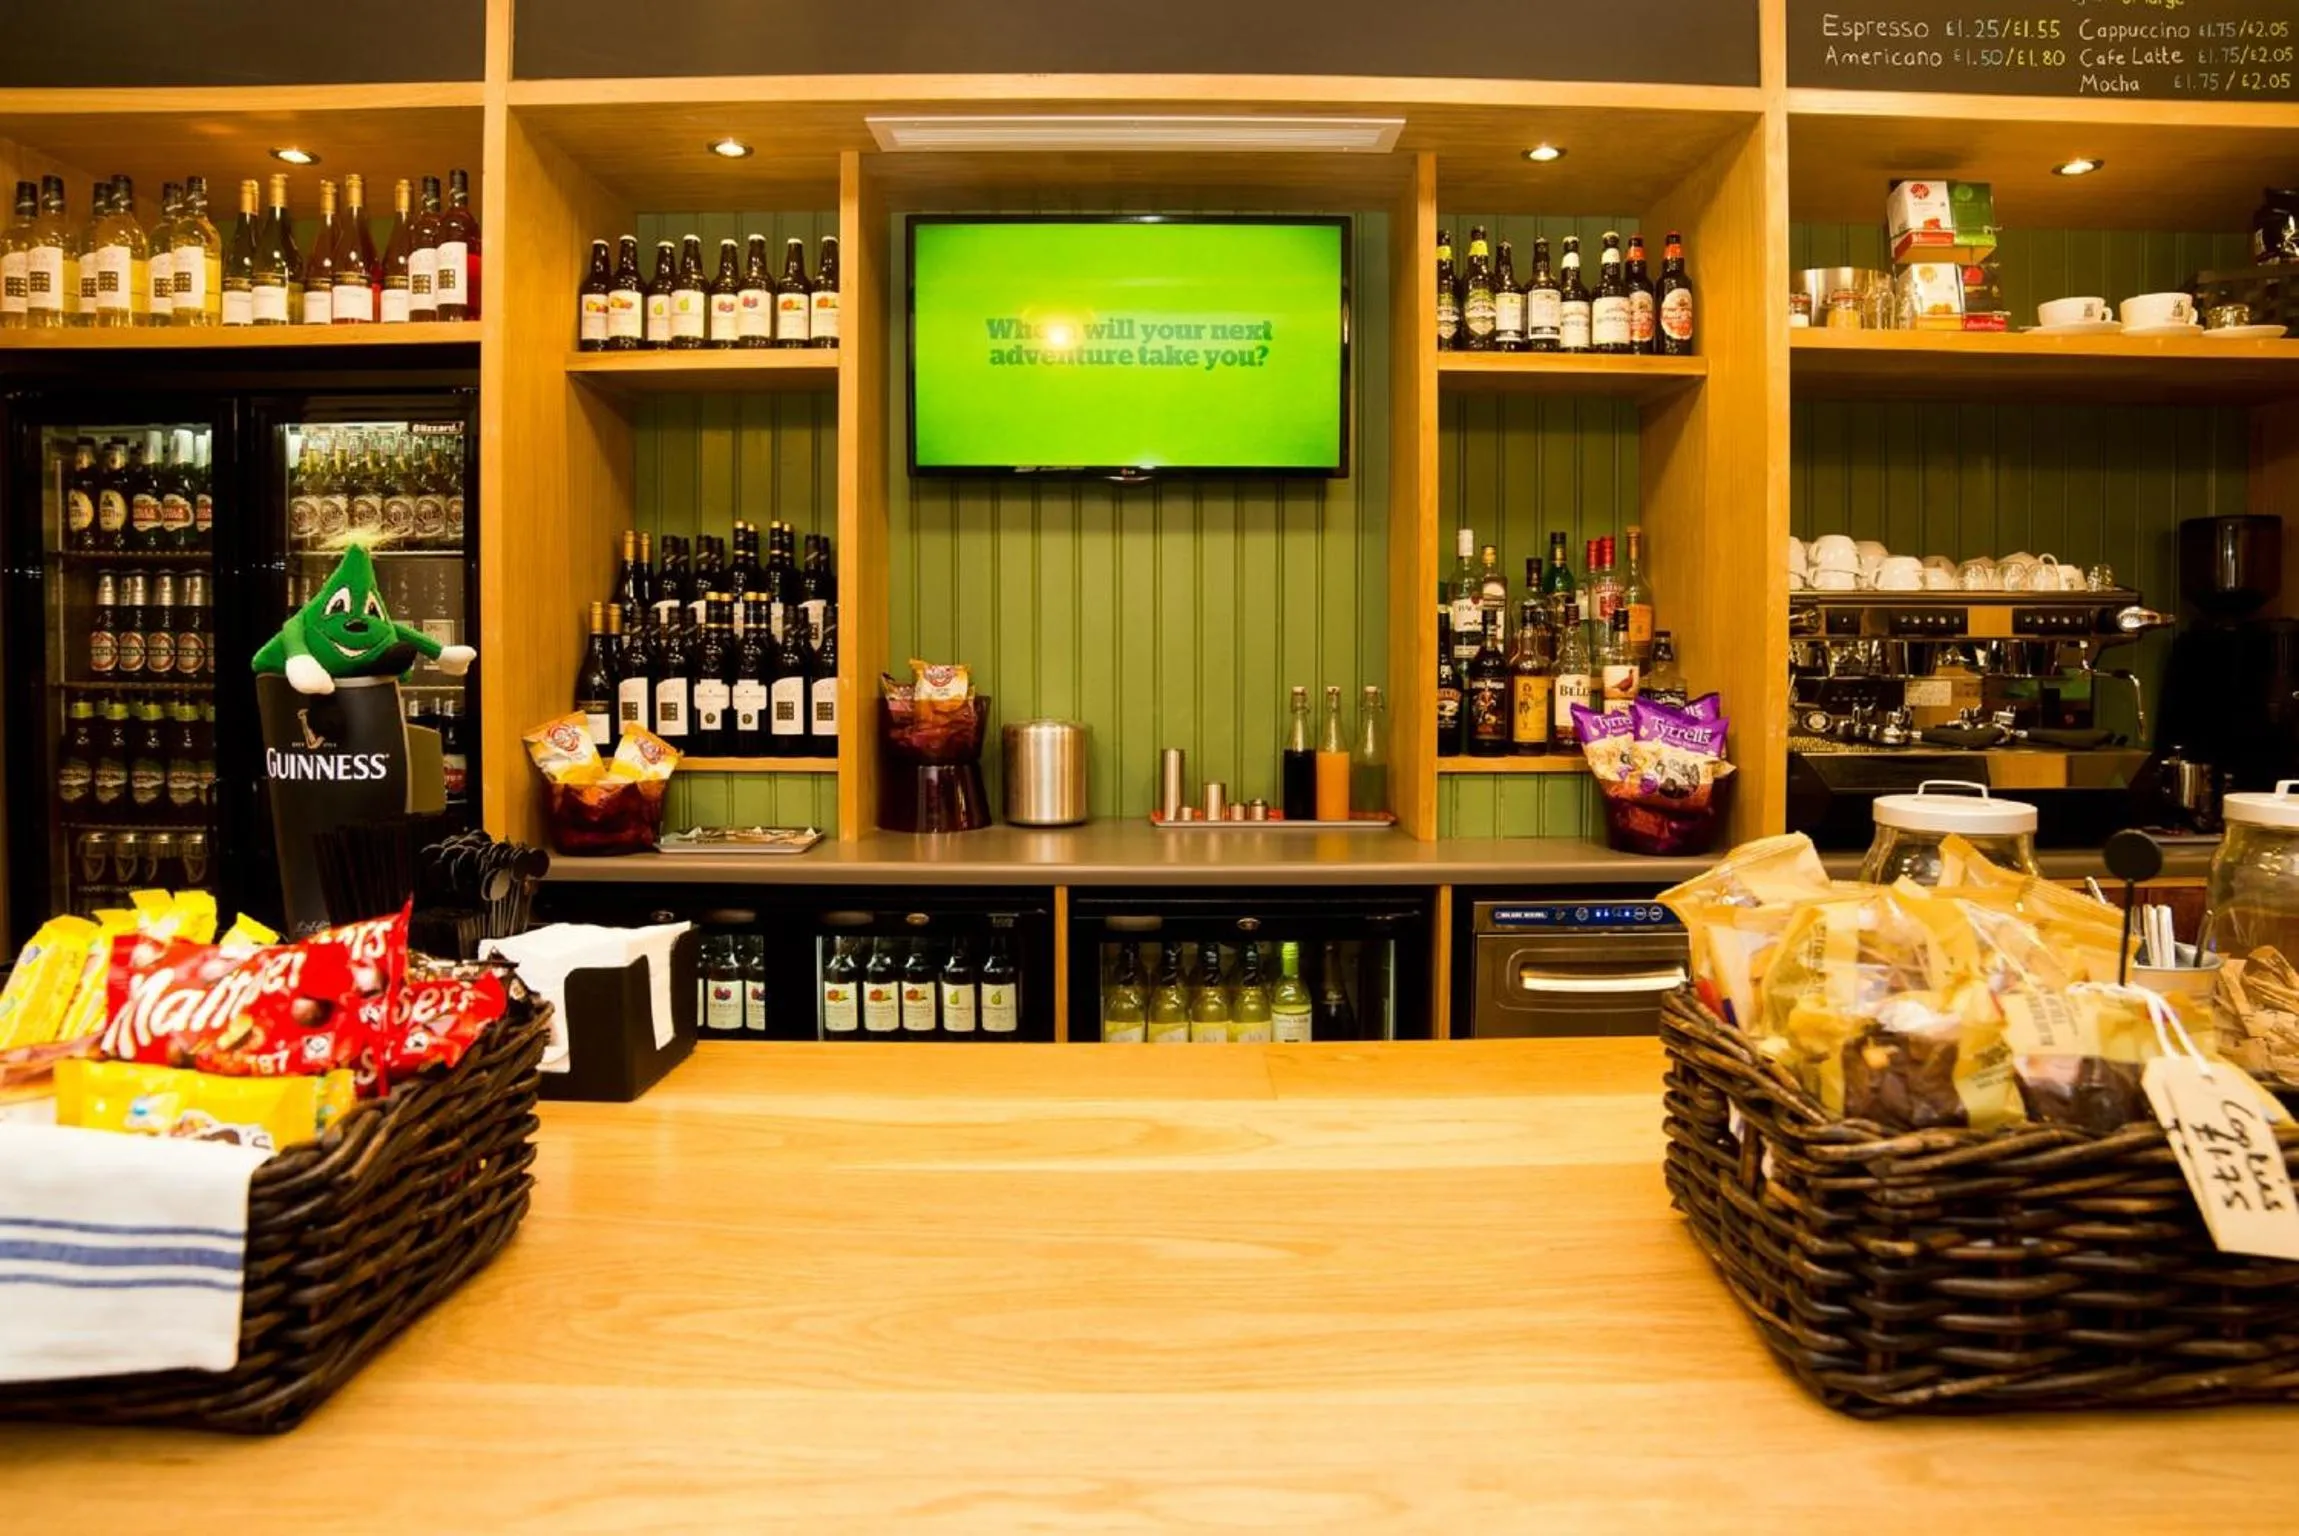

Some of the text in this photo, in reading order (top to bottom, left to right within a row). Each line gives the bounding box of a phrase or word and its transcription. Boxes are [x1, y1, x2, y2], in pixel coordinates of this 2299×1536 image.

[1822, 13, 1929, 42] Espresso
[2079, 18, 2191, 42] Cappuccino
[1824, 44, 1943, 67] Americano
[2079, 48, 2126, 68] Cafe
[2131, 46, 2185, 66] Latte
[2079, 73, 2141, 93] Mocha
[1083, 316, 1135, 341] will
[1141, 323, 1205, 344] your
[1211, 320, 1273, 341] next
[988, 344, 1271, 371] adventure take you?
[266, 747, 388, 780] GUINNESS
